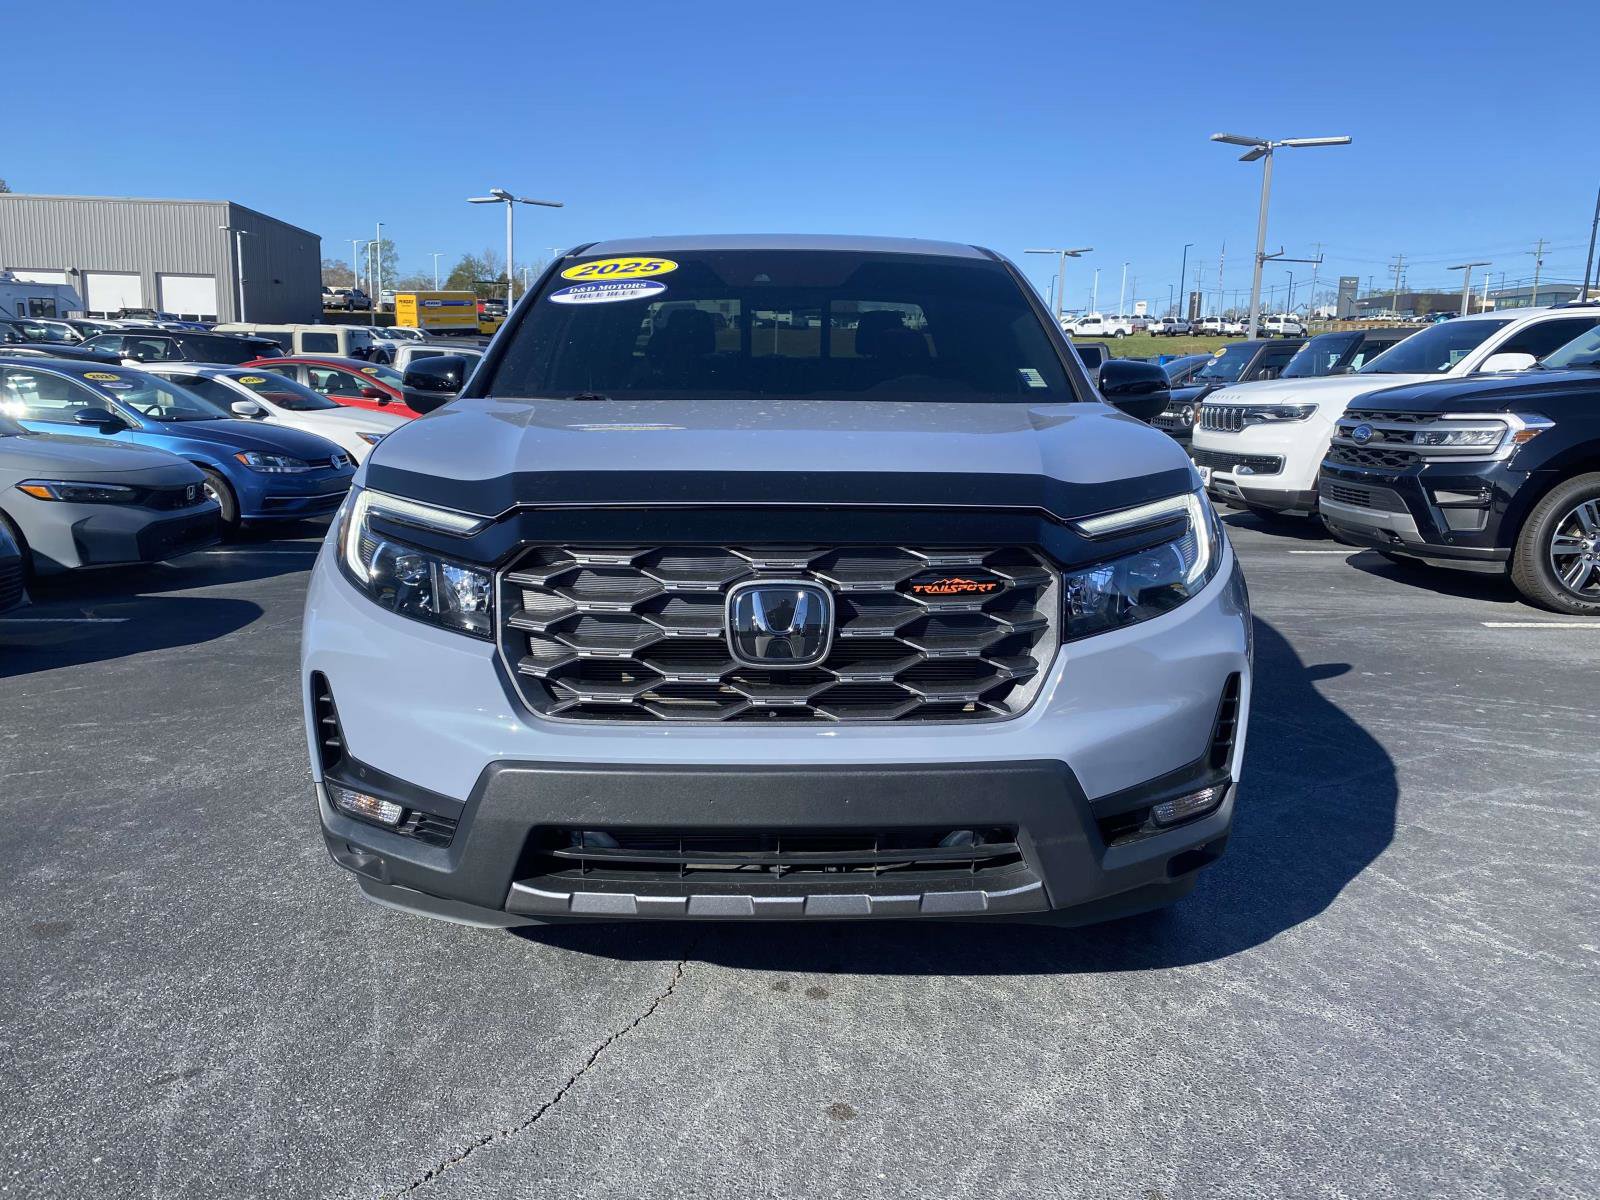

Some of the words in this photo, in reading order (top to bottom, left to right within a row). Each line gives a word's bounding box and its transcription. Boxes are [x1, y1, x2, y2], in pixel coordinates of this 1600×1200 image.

[575, 262, 665, 277] 2025
[569, 286, 596, 294] D&D
[598, 282, 647, 291] MOTORS
[913, 583, 997, 594] TRAILSPORT
